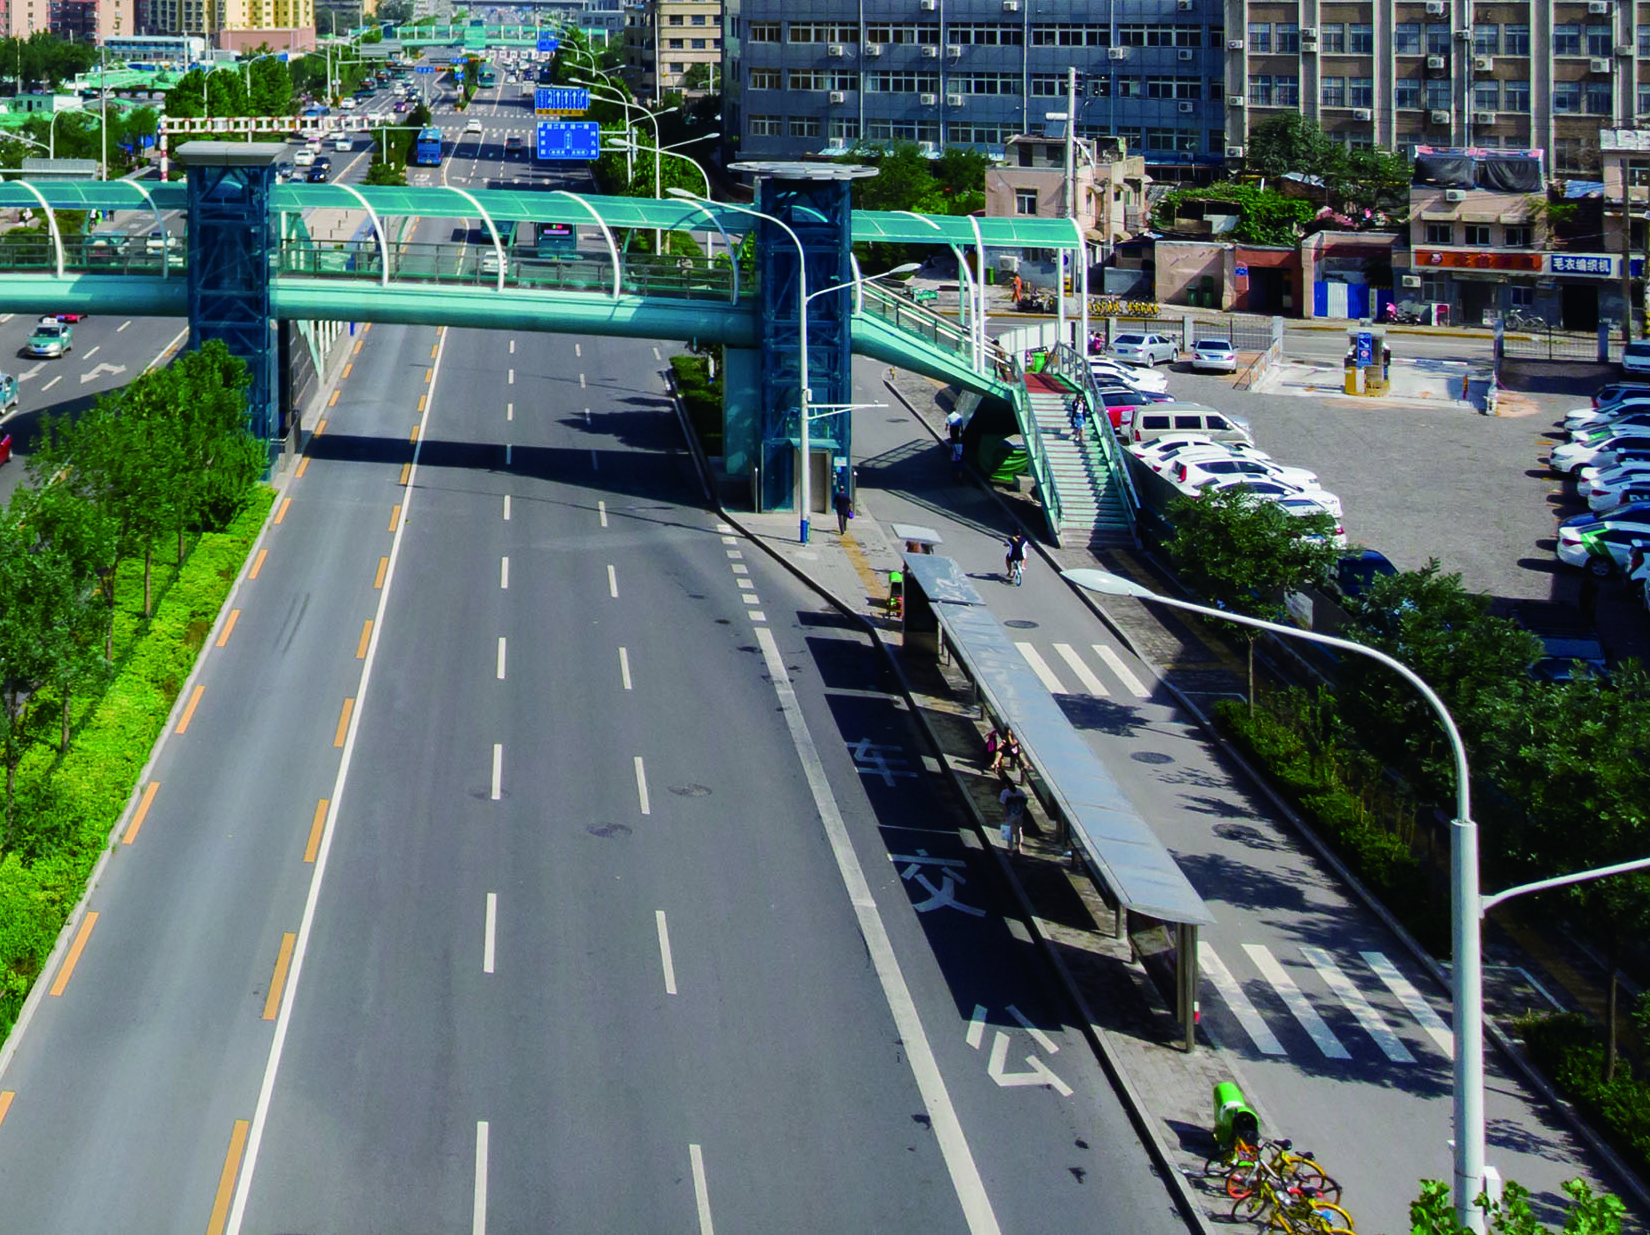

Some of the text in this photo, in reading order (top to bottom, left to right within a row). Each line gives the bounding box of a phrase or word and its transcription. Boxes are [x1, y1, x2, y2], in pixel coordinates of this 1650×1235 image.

[1553, 257, 1610, 273] 毛衣编织机
